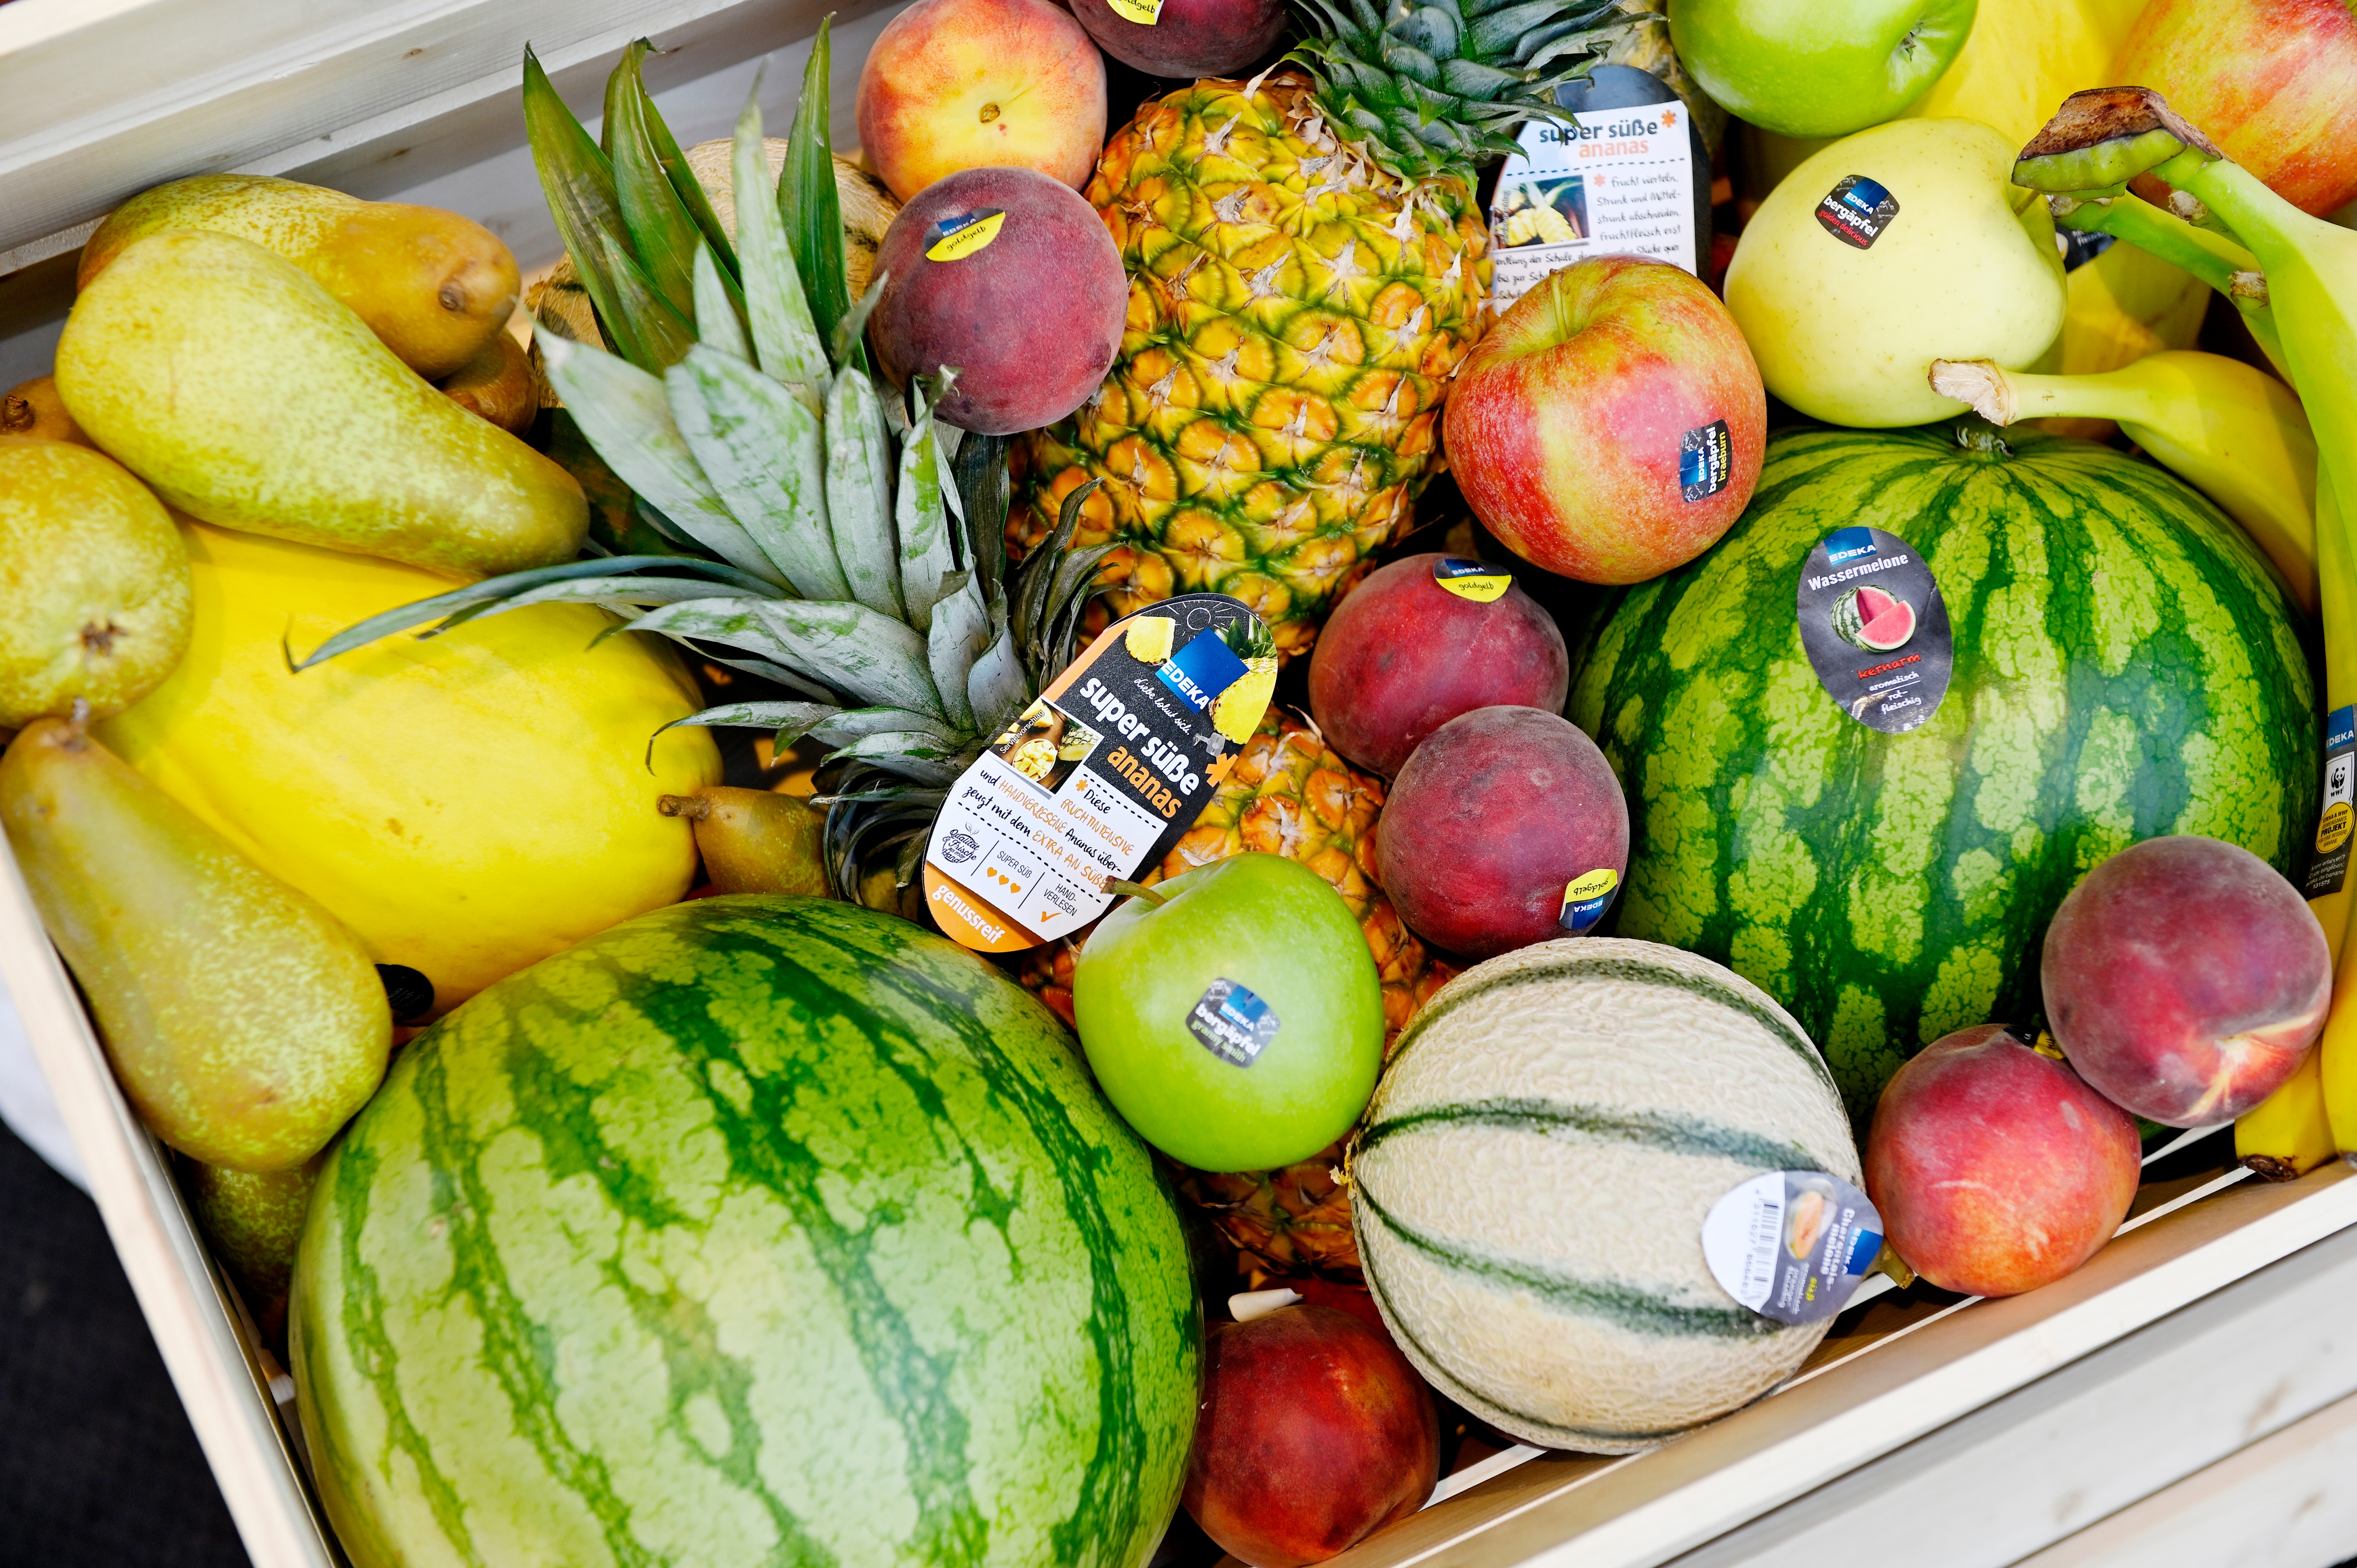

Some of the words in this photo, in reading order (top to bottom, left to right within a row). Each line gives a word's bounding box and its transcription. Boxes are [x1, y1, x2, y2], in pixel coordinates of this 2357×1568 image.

[1540, 125, 1603, 145] super
[1609, 119, 1658, 138] süße
[1580, 140, 1649, 158] ananas
[1631, 192, 1648, 202] und
[1844, 192, 1874, 215] EDEKA
[1823, 195, 1879, 237] bergäpfel
[942, 218, 976, 237] EDEKA
[1664, 224, 1681, 234] erst
[1818, 209, 1840, 226] golden
[1839, 223, 1869, 246] delicious
[947, 226, 986, 251] goldgelb
[1706, 426, 1720, 493] bergäpfel
[1718, 431, 1727, 482] braeburn
[1829, 544, 1876, 562] EDEKA
[1452, 567, 1485, 575] EDEKA
[1807, 554, 1909, 591] Wassermelone
[1459, 581, 1494, 591] goldgelb
[1857, 654, 1921, 680] kernarm
[1160, 659, 1210, 710] EDEKA
[1869, 671, 1919, 691] aromatisch
[1881, 697, 1922, 715] fleischig
[1888, 690, 1908, 701] rot-
[1000, 710, 1045, 754] Serviervorschlag
[1079, 678, 1150, 741] super
[1141, 737, 1200, 796] süße
[1174, 718, 1192, 735] sich.
[1107, 746, 1182, 818] ananas
[1083, 789, 1111, 813] Diese
[2331, 789, 2344, 797] WWF
[962, 787, 993, 809] zeugt
[991, 804, 1012, 820] mit
[1010, 816, 1031, 837] dem
[1032, 830, 1063, 860] EXTRA
[1064, 854, 1082, 870] AN
[980, 770, 1002, 786] und
[998, 780, 1068, 833] HANDVERLESENE
[1065, 828, 1098, 858] Ananas
[1097, 851, 1121, 872] über-
[2322, 816, 2347, 829] GEMEINSAMES
[2323, 814, 2334, 823] EDEKA
[950, 829, 980, 850] Qualität
[2321, 822, 2346, 837] PROJEKT
[2332, 829, 2347, 838] BESSERE
[948, 840, 977, 860] Frische
[2324, 838, 2338, 847] BANANE
[941, 848, 961, 863] Hand
[997, 851, 1019, 869] SUPER
[1055, 884, 1076, 901] HAND-
[1574, 877, 1609, 896] goldgelb
[2313, 879, 2330, 889] 131575
[1044, 888, 1078, 916] VERLESEN
[1574, 899, 1603, 912] EDEKA
[932, 885, 1006, 944] genussreif
[1221, 1003, 1255, 1032] EDEKA
[1195, 1003, 1261, 1056] bergäpfel
[1191, 1020, 1223, 1046] granny
[1221, 1042, 1246, 1063] smith
[1820, 1223, 1840, 1275] melone
[1827, 1208, 1855, 1291] Charentais-
[1841, 1227, 1862, 1275] EDEKA
